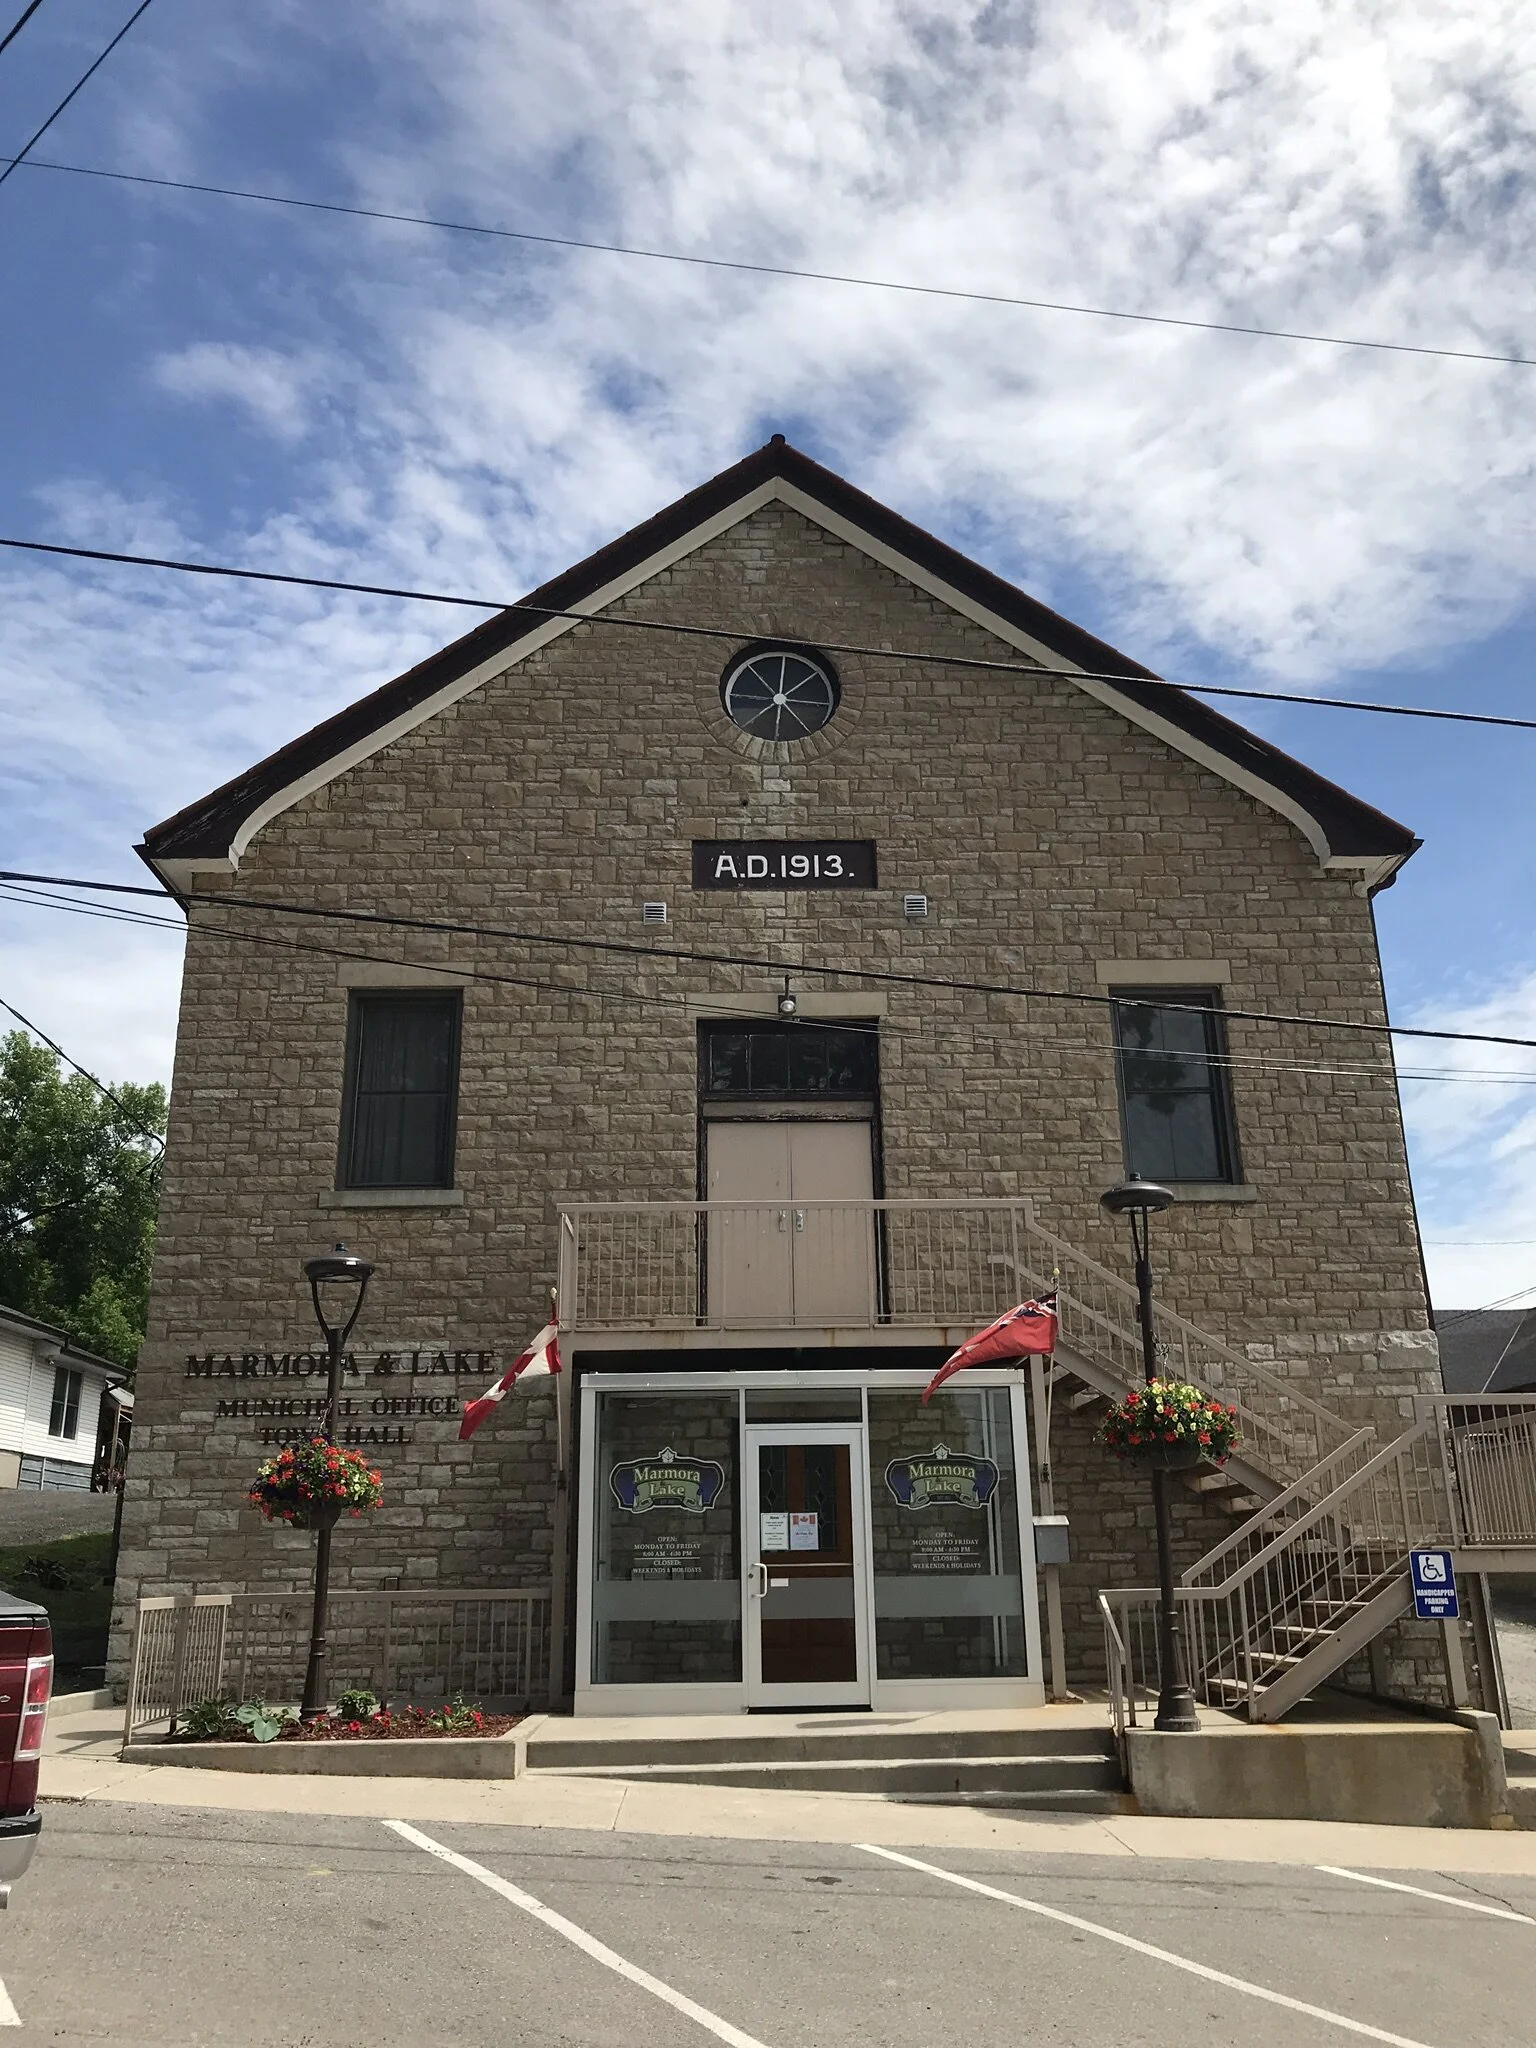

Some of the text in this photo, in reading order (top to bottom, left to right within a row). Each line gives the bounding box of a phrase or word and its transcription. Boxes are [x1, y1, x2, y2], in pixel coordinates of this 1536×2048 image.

[373, 1351, 394, 1377] &
[412, 1350, 496, 1375] LAKE
[216, 1396, 460, 1417] MUNICIPL OFFICE
[259, 1425, 412, 1447] TOW HALL
[634, 1467, 700, 1482] Marmora
[909, 1463, 975, 1478] Marmora
[650, 1484, 685, 1496] Lake
[926, 1480, 960, 1492] Lake
